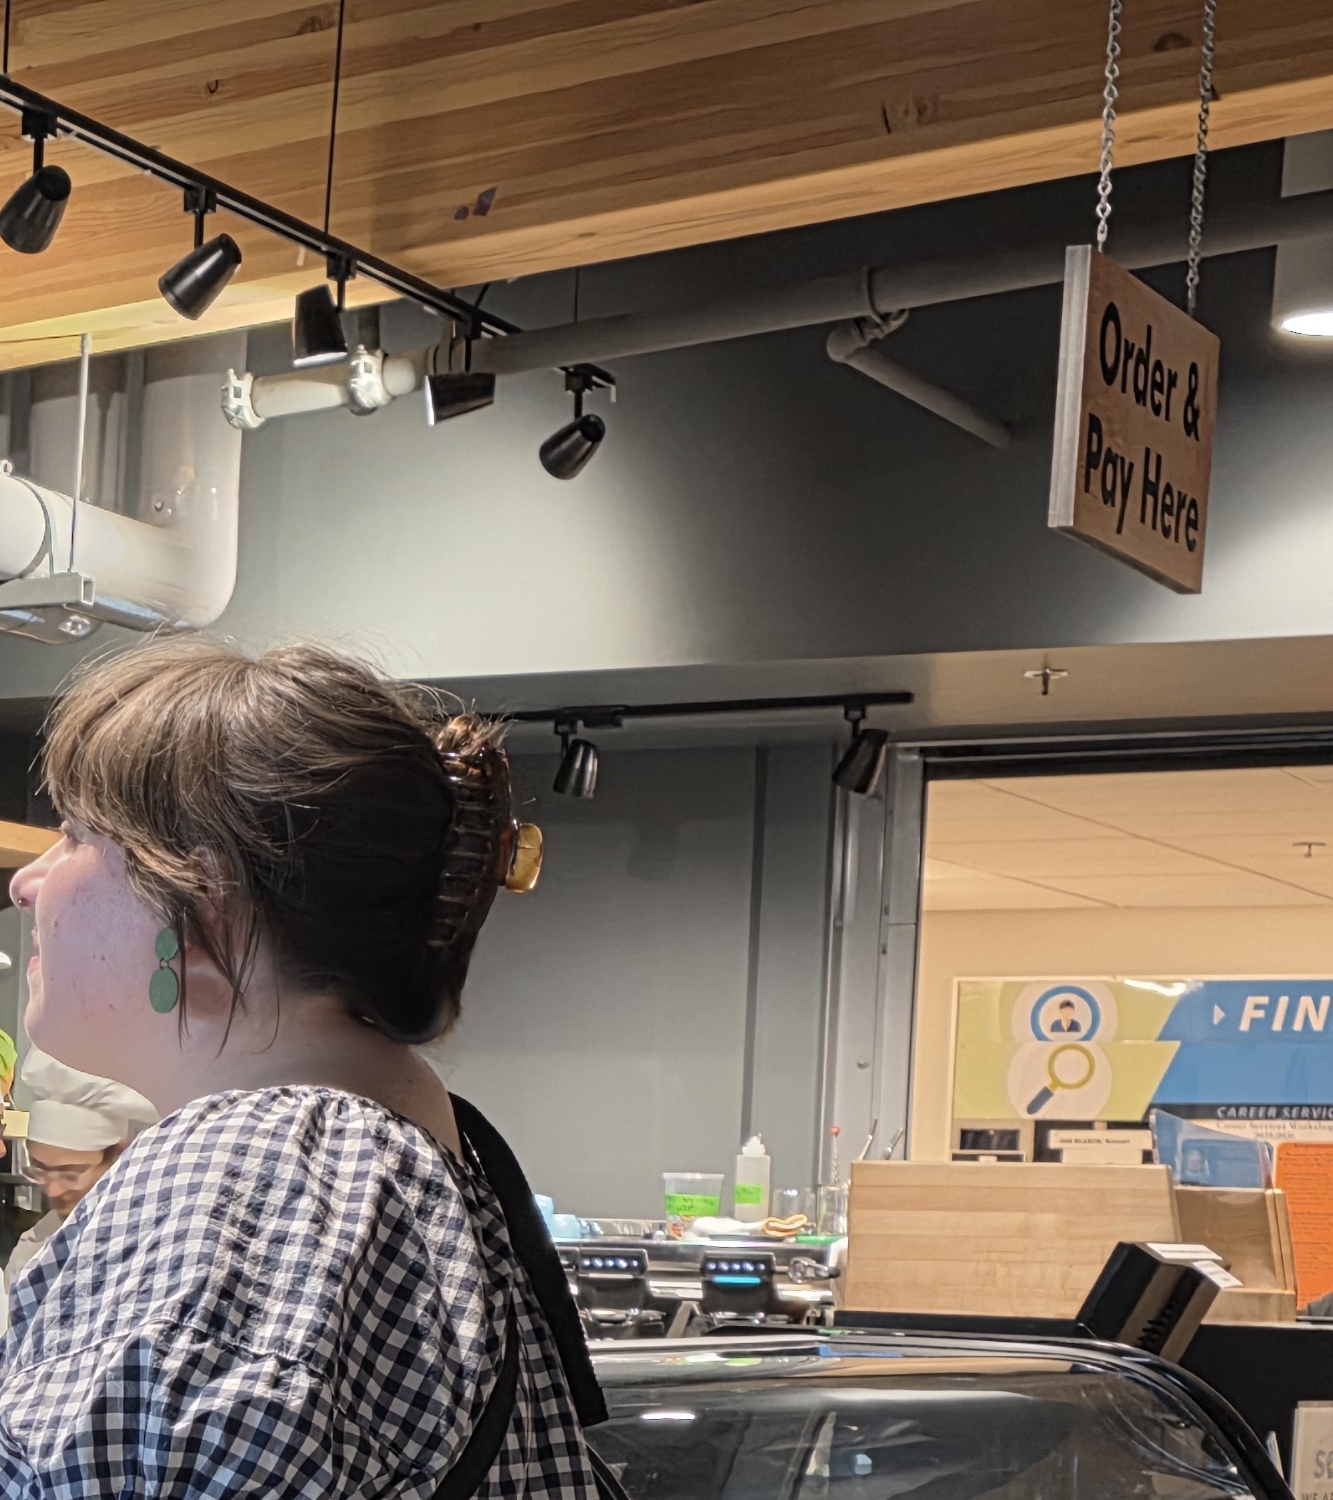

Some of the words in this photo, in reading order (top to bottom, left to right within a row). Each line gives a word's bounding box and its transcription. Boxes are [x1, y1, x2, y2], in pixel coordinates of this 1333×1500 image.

[1099, 302, 1177, 421] Order
[1183, 361, 1200, 442] &
[1085, 412, 1134, 534] Pay
[1140, 447, 1199, 553] Here
[1239, 995, 1331, 1032] FIN
[1217, 1106, 1277, 1119] CAREER
